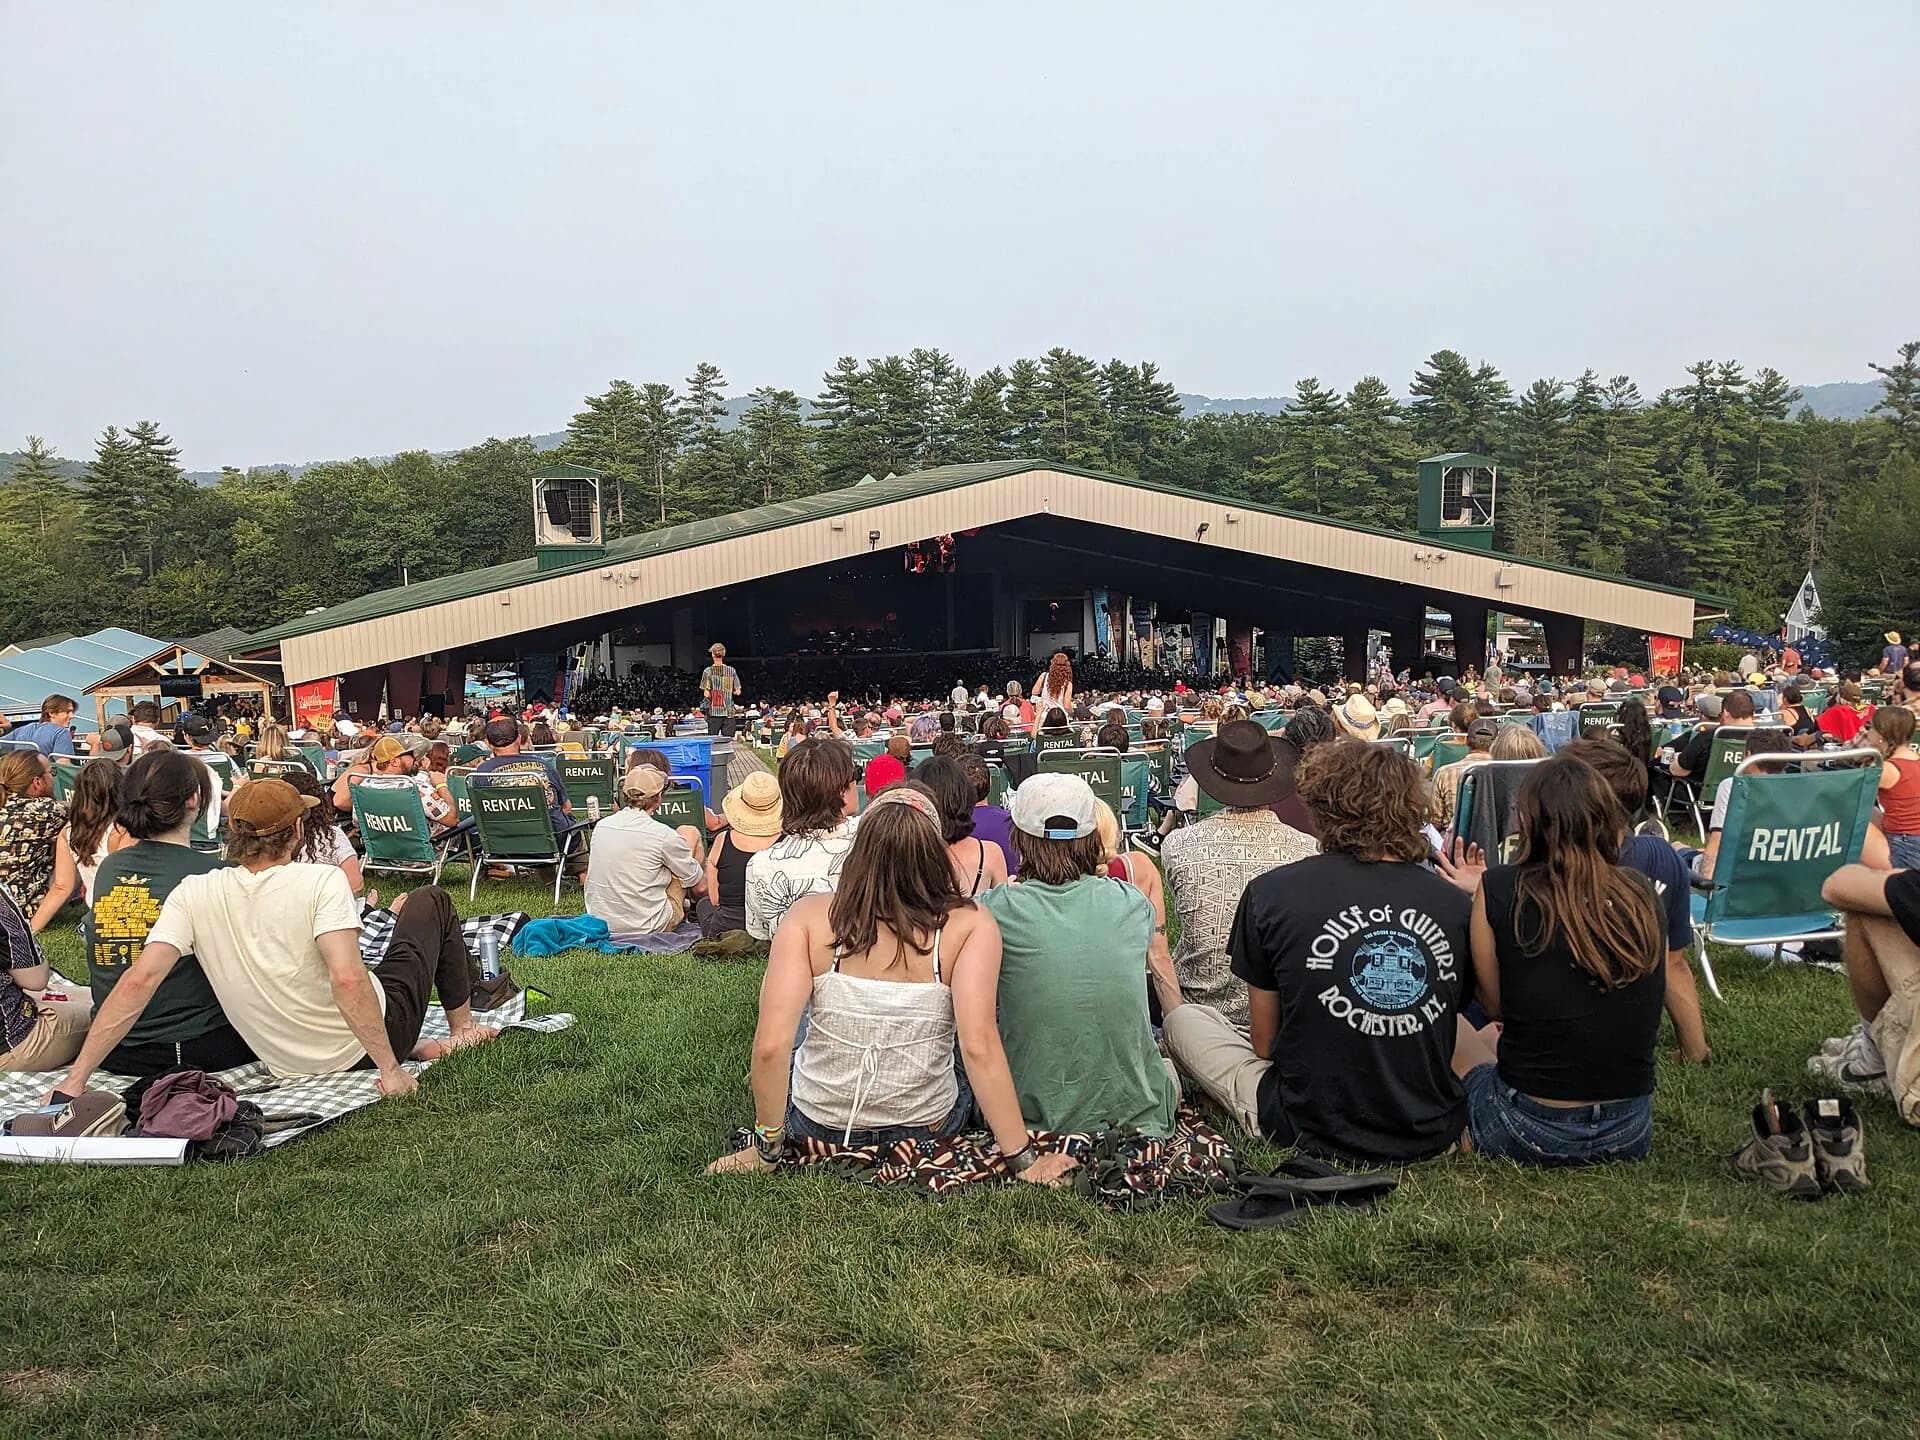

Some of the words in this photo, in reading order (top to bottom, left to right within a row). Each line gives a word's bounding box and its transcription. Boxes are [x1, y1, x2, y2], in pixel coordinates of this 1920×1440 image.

[1043, 739, 1074, 749] RENTAL
[565, 767, 604, 777] RENTAL
[482, 797, 536, 813] RENTAL
[364, 812, 412, 832] RENTAL
[1748, 821, 1842, 862] RENTAL
[1305, 904, 1370, 970] HOUSE
[1369, 903, 1393, 923] of
[1400, 908, 1457, 982] GUITARS
[1419, 993, 1447, 1025] N.Y.
